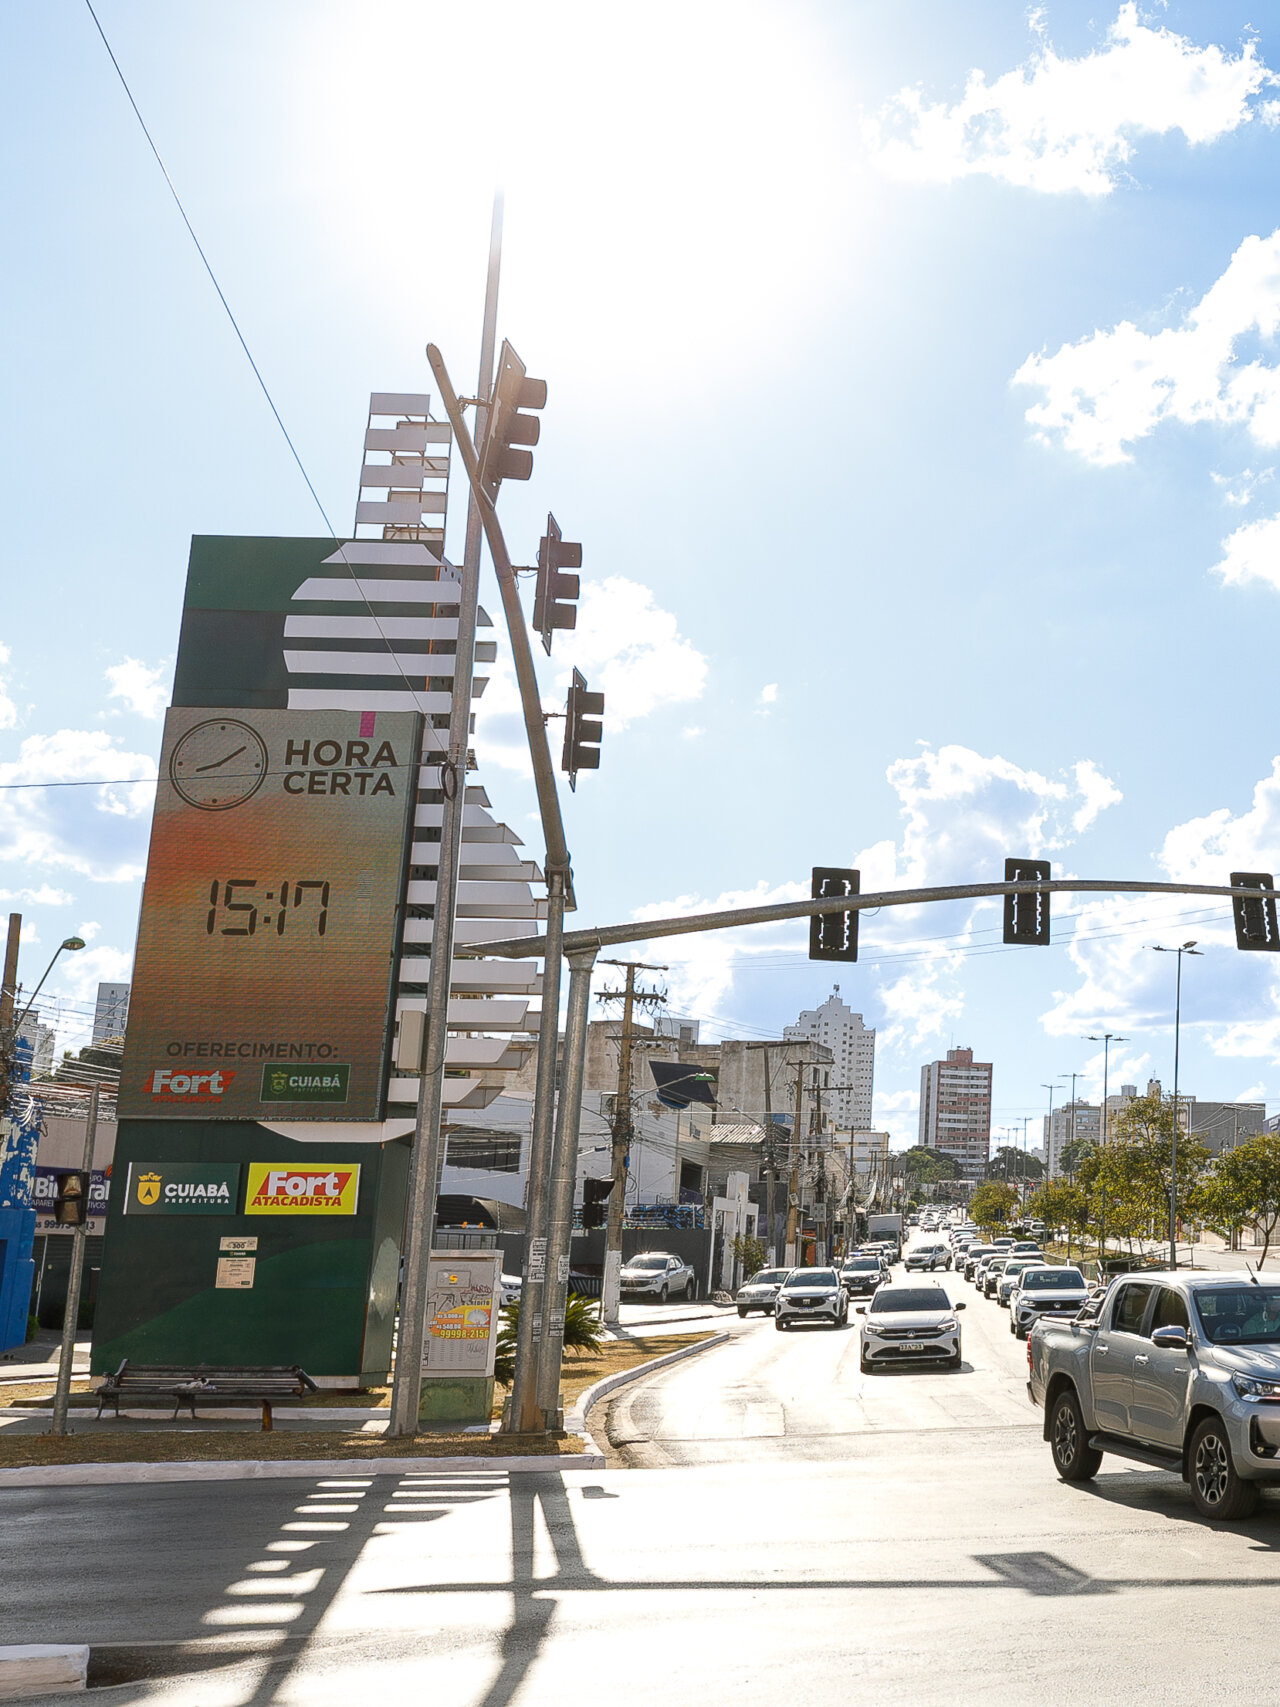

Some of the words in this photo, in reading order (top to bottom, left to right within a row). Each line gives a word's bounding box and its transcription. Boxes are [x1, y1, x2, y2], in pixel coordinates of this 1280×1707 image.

[285, 739, 398, 767] HORA
[283, 771, 396, 796] CERTA
[206, 879, 330, 936] 15:17
[166, 1041, 339, 1059] OFERECIMENTO:
[152, 1069, 225, 1094] Fort
[289, 1074, 341, 1088] CUIABÁ
[164, 1182, 230, 1197] CUIABÁ
[267, 1171, 338, 1197] Fort
[251, 1196, 342, 1207] ATACADISTA
[440, 1329, 489, 1338] 99998-2150
